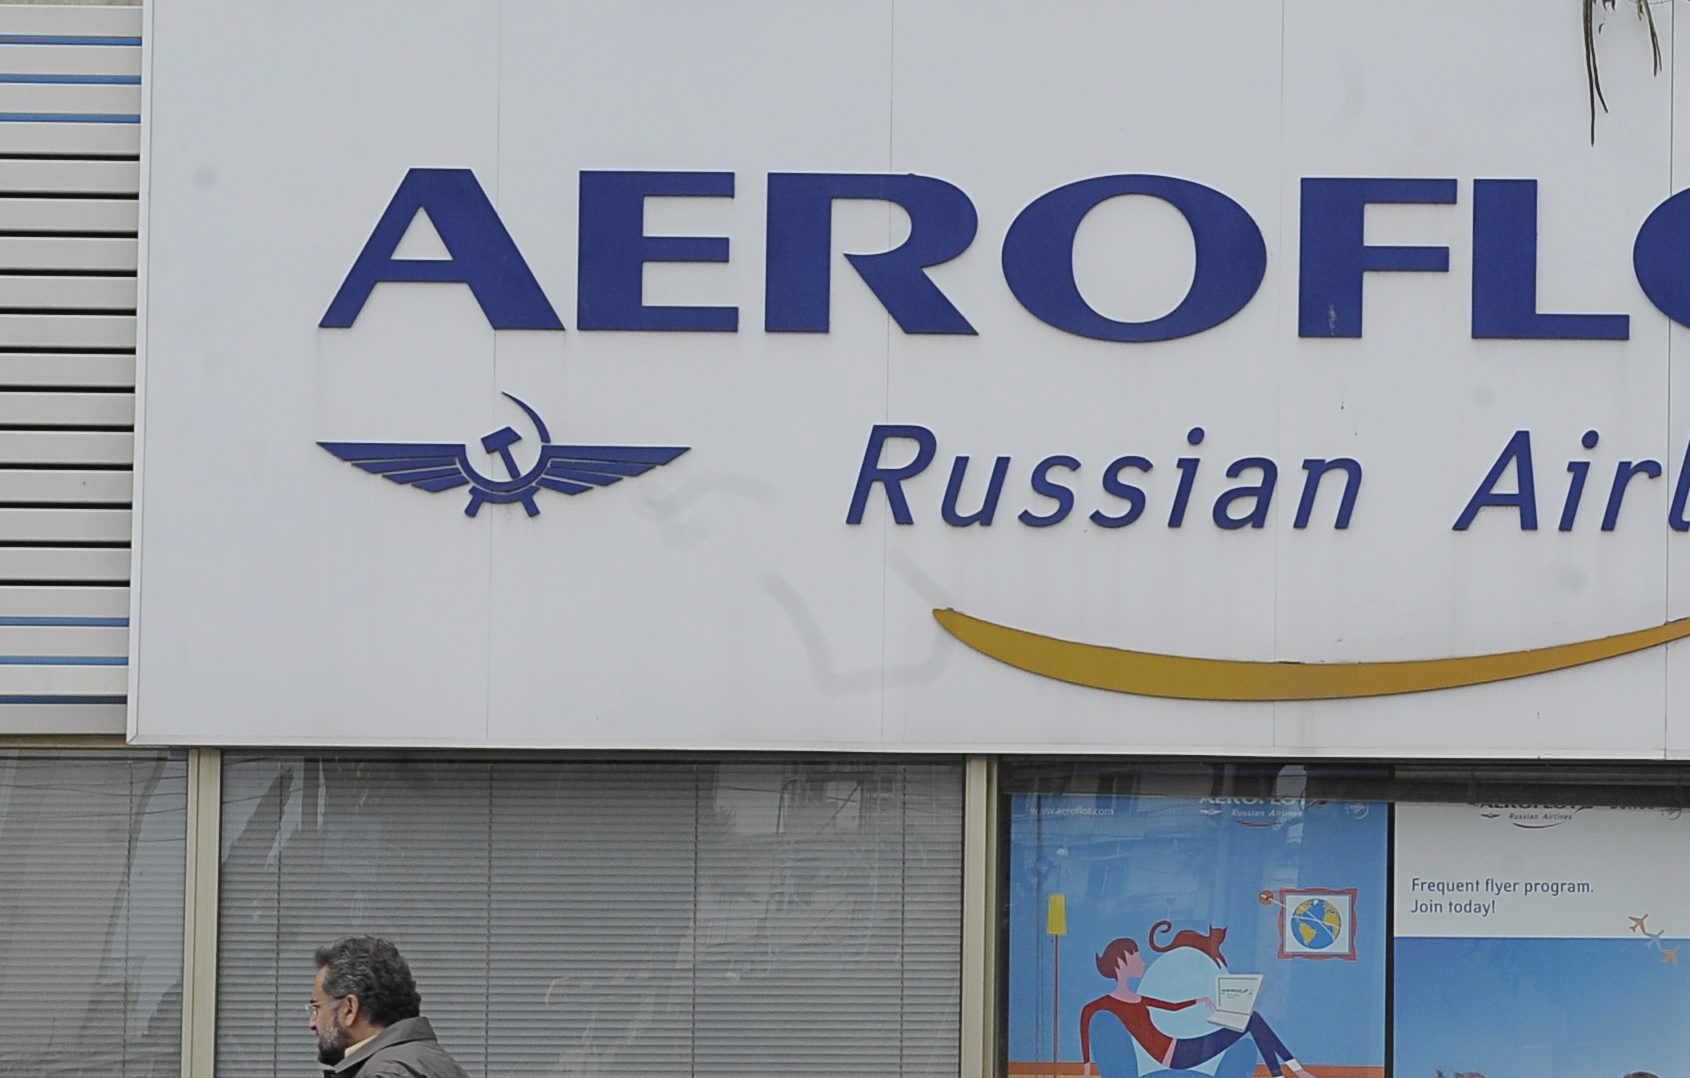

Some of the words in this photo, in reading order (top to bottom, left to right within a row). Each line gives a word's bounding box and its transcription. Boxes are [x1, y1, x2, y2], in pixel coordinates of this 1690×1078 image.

[845, 423, 1364, 531] Russian
[1508, 812, 1539, 820] Russian
[1542, 812, 1573, 821] Airlines
[1411, 878, 1480, 895] Frequent
[1485, 878, 1519, 896] flyer
[1524, 881, 1594, 896] program.
[1410, 899, 1443, 913] Join
[1448, 899, 1496, 917] today!
